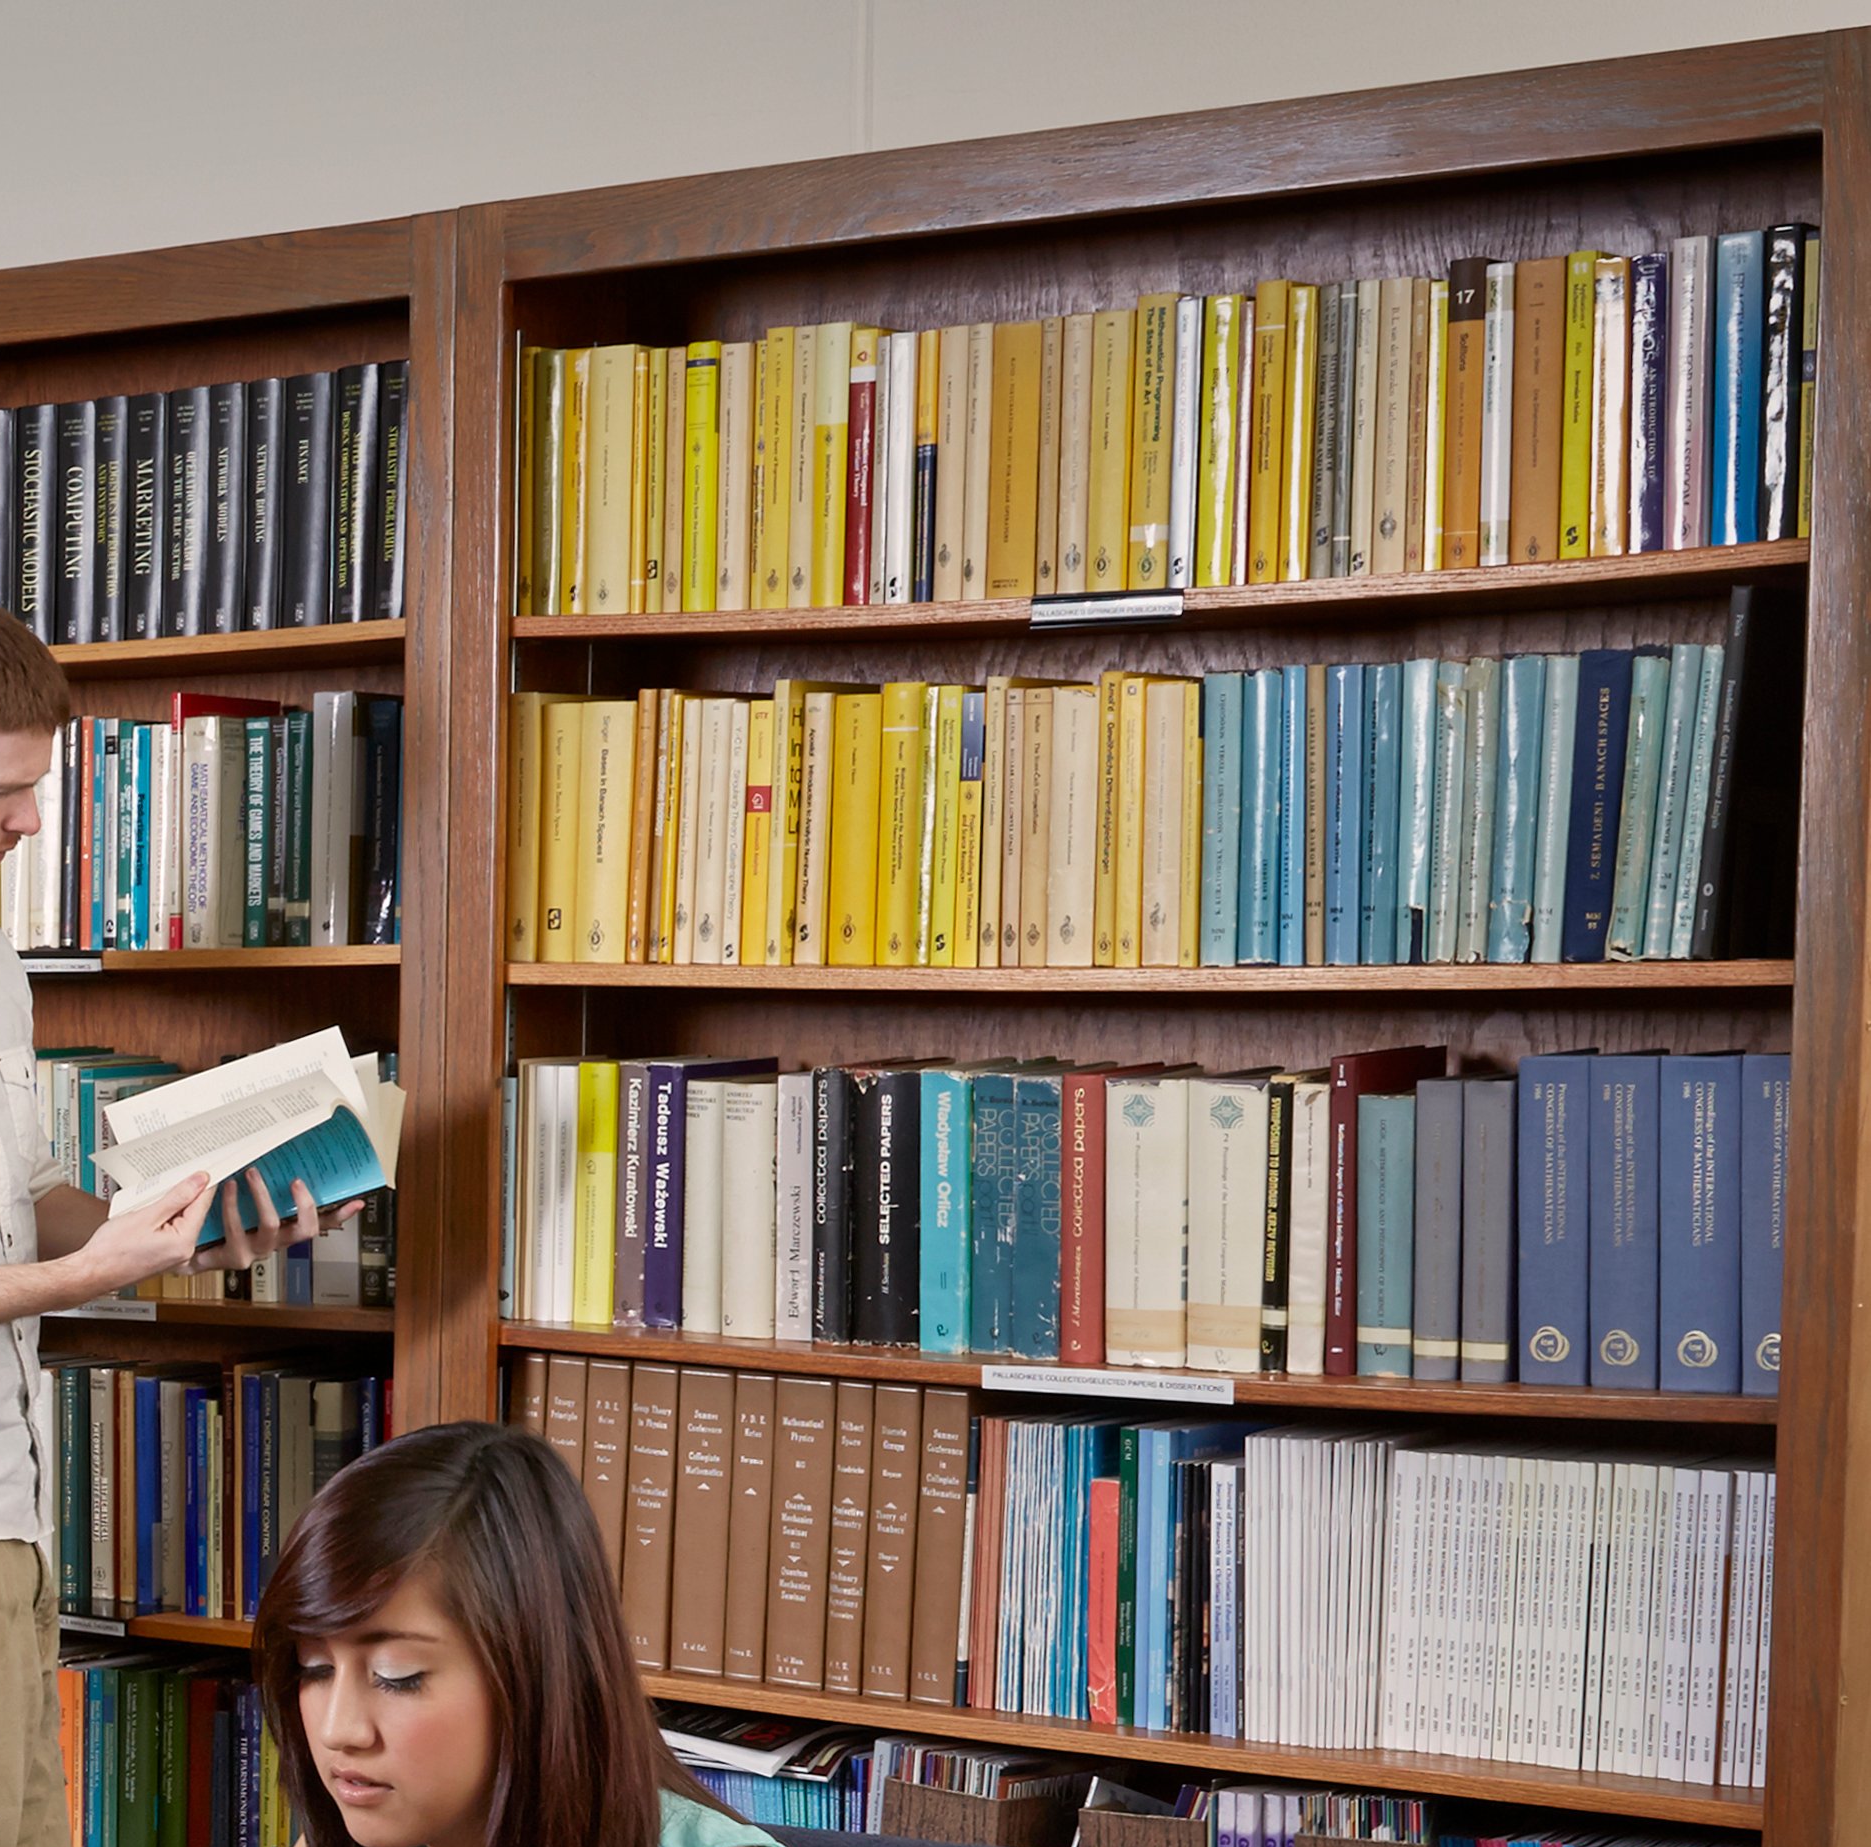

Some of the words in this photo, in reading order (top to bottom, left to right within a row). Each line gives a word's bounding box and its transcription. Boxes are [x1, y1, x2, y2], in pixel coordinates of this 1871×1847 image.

[1147, 308, 1155, 325] The
[1456, 290, 1475, 304] 17
[1146, 357, 1154, 368] of
[1155, 308, 1166, 373] Mathematical
[1460, 333, 1469, 371] Solitons
[1144, 390, 1152, 406] Art
[1145, 371, 1153, 386] the
[1152, 376, 1163, 442] Programming
[255, 445, 267, 494] NETWORK
[298, 439, 309, 484] FINANCE
[24, 449, 43, 544] STOCHASTIC
[134, 459, 154, 576] MARKETING
[65, 466, 85, 579] COMPUTING
[21, 548, 40, 613] MODELS
[1598, 687, 1610, 735] SPACES
[249, 736, 264, 754] THE
[1595, 740, 1608, 790] BANACH
[190, 762, 199, 791] GAME
[249, 756, 263, 792] THEORY
[190, 793, 198, 816] AND
[200, 763, 209, 840] MATHEMATICAL
[248, 809, 263, 840] GAMES
[249, 794, 263, 808] OF
[248, 843, 262, 861] AND
[1591, 801, 1604, 867] SEMADENI
[198, 842, 208, 892] METHODS
[248, 863, 262, 907] MARKETS
[627, 1078, 643, 1152] Kazimierz
[656, 1082, 672, 1155] Tadeusz
[817, 1079, 829, 1140] papers
[880, 1094, 893, 1158] PAPERS
[1074, 1087, 1087, 1153] papers
[1694, 1082, 1705, 1135] CONGRESS
[816, 1146, 828, 1224] collected
[1269, 1157, 1279, 1168] TO
[624, 1154, 641, 1238] Kuratowski
[879, 1160, 892, 1245] SELECTED
[937, 1181, 952, 1228] Orlicz
[1072, 1158, 1085, 1238] collected
[1691, 1153, 1703, 1246] MATHEMATICIANS
[788, 1185, 802, 1262] Marczewski
[787, 1270, 800, 1319] Edward
[1127, 1380, 1158, 1389] PAPERS
[239, 1759, 249, 1835] PARSIMONIOUS
